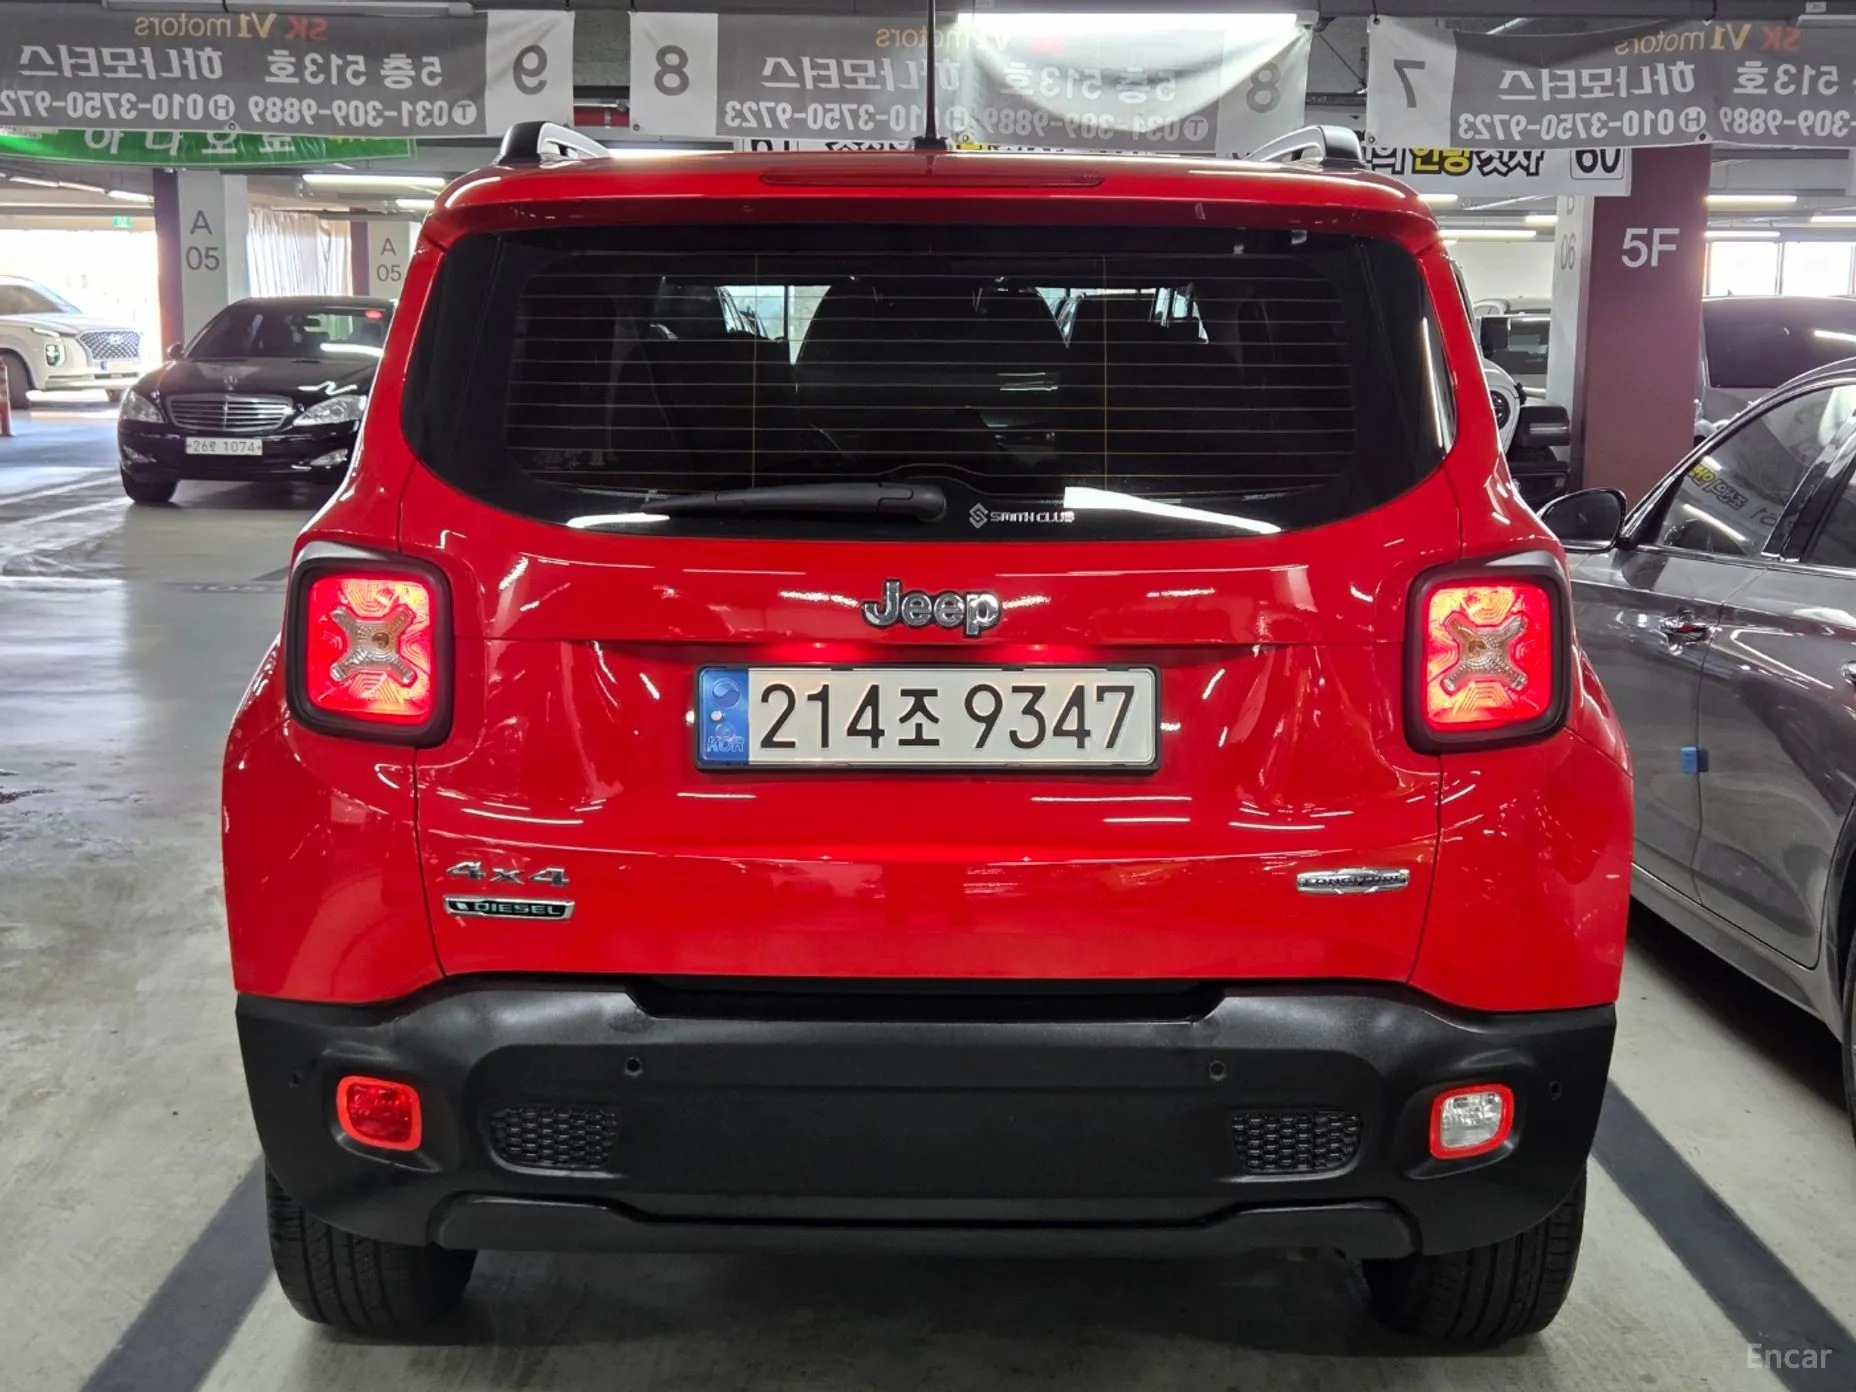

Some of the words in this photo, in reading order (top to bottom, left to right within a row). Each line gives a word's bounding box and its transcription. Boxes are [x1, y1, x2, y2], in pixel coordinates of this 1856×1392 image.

[654, 45, 690, 96] 8
[190, 210, 213, 236] A
[186, 246, 220, 272] 05
[380, 237, 397, 257] A
[1560, 233, 1576, 270] 06
[1621, 228, 1680, 268] 5F
[376, 264, 402, 283] 05
[223, 440, 256, 454] 1074
[862, 579, 1002, 638] Jeep
[760, 683, 940, 750] 214조
[964, 683, 1136, 750] 9347
[705, 735, 745, 753] KOR
[474, 900, 562, 916] DIESEL
